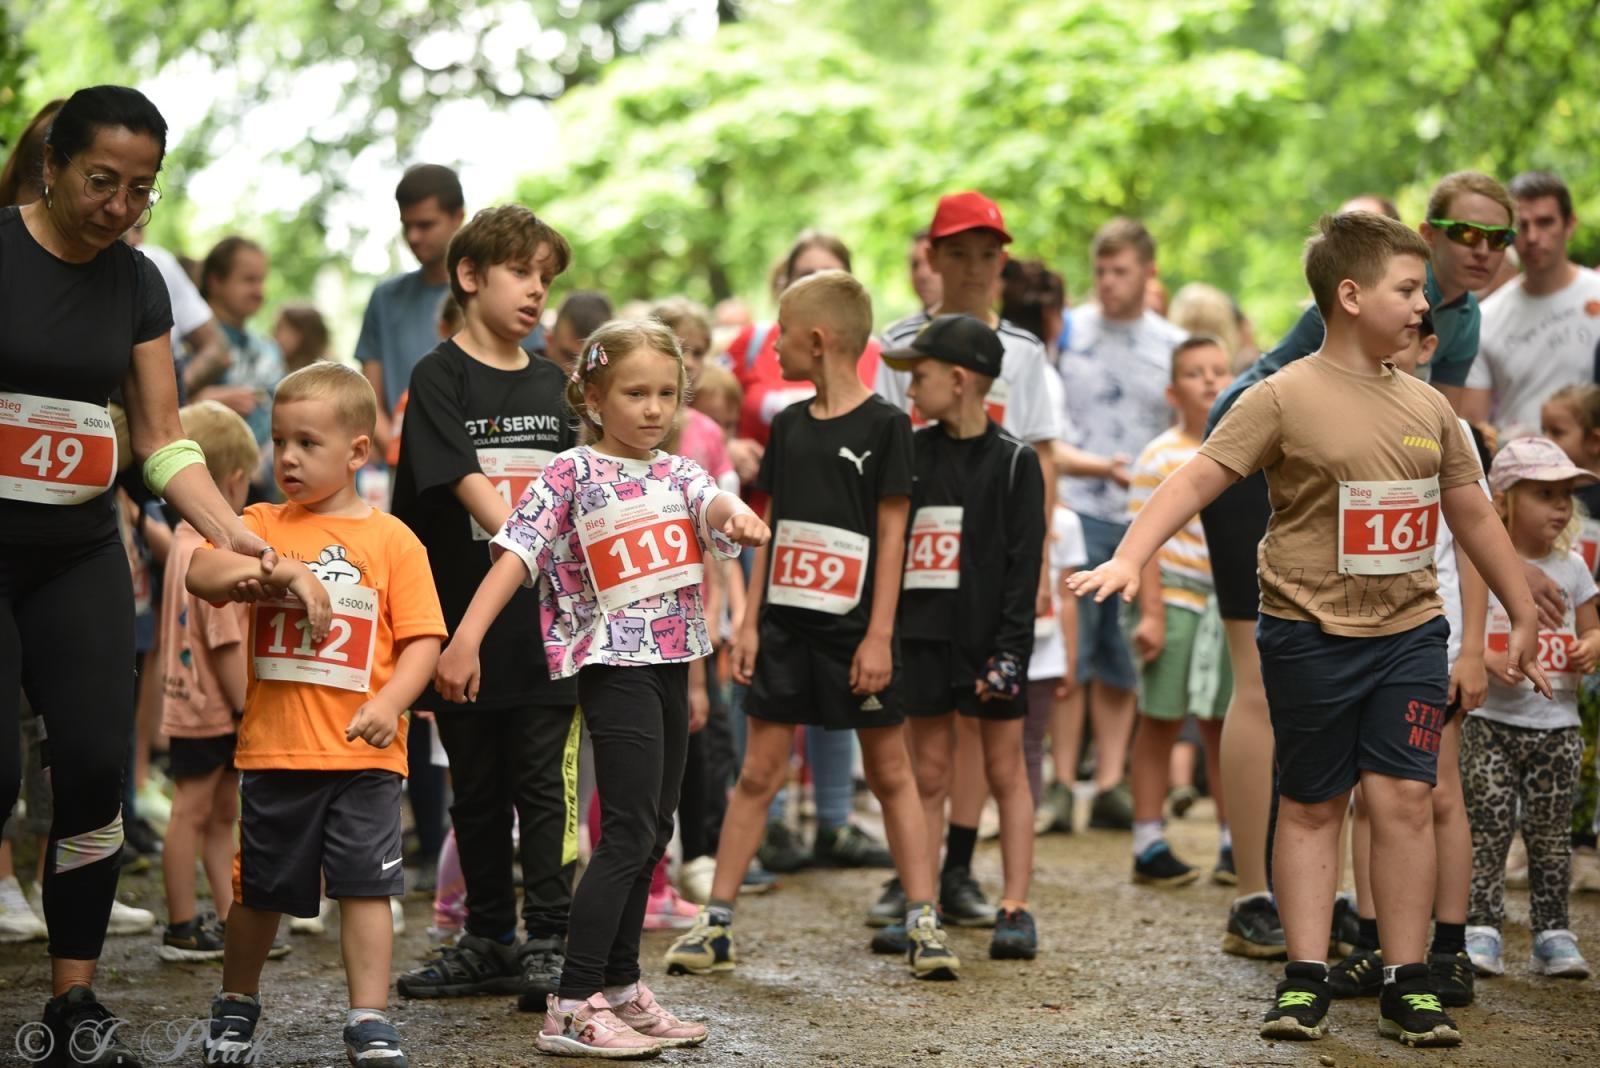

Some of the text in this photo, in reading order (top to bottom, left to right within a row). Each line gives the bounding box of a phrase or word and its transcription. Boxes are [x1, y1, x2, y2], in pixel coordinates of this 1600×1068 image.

[84, 417, 102, 428] 4500
[104, 420, 111, 429] M
[465, 415, 559, 436] GTX SERVIC
[501, 434, 535, 444] ECONOMY
[20, 435, 83, 479] 49
[1350, 488, 1372, 499] Bieg
[662, 504, 680, 514] 4500
[585, 517, 606, 531] Bieg
[1364, 510, 1428, 551] 161
[608, 524, 688, 580] 119
[780, 550, 845, 591] 159
[338, 598, 373, 612] 4500 M
[268, 612, 352, 662] 112
[1537, 636, 1567, 670] 28
